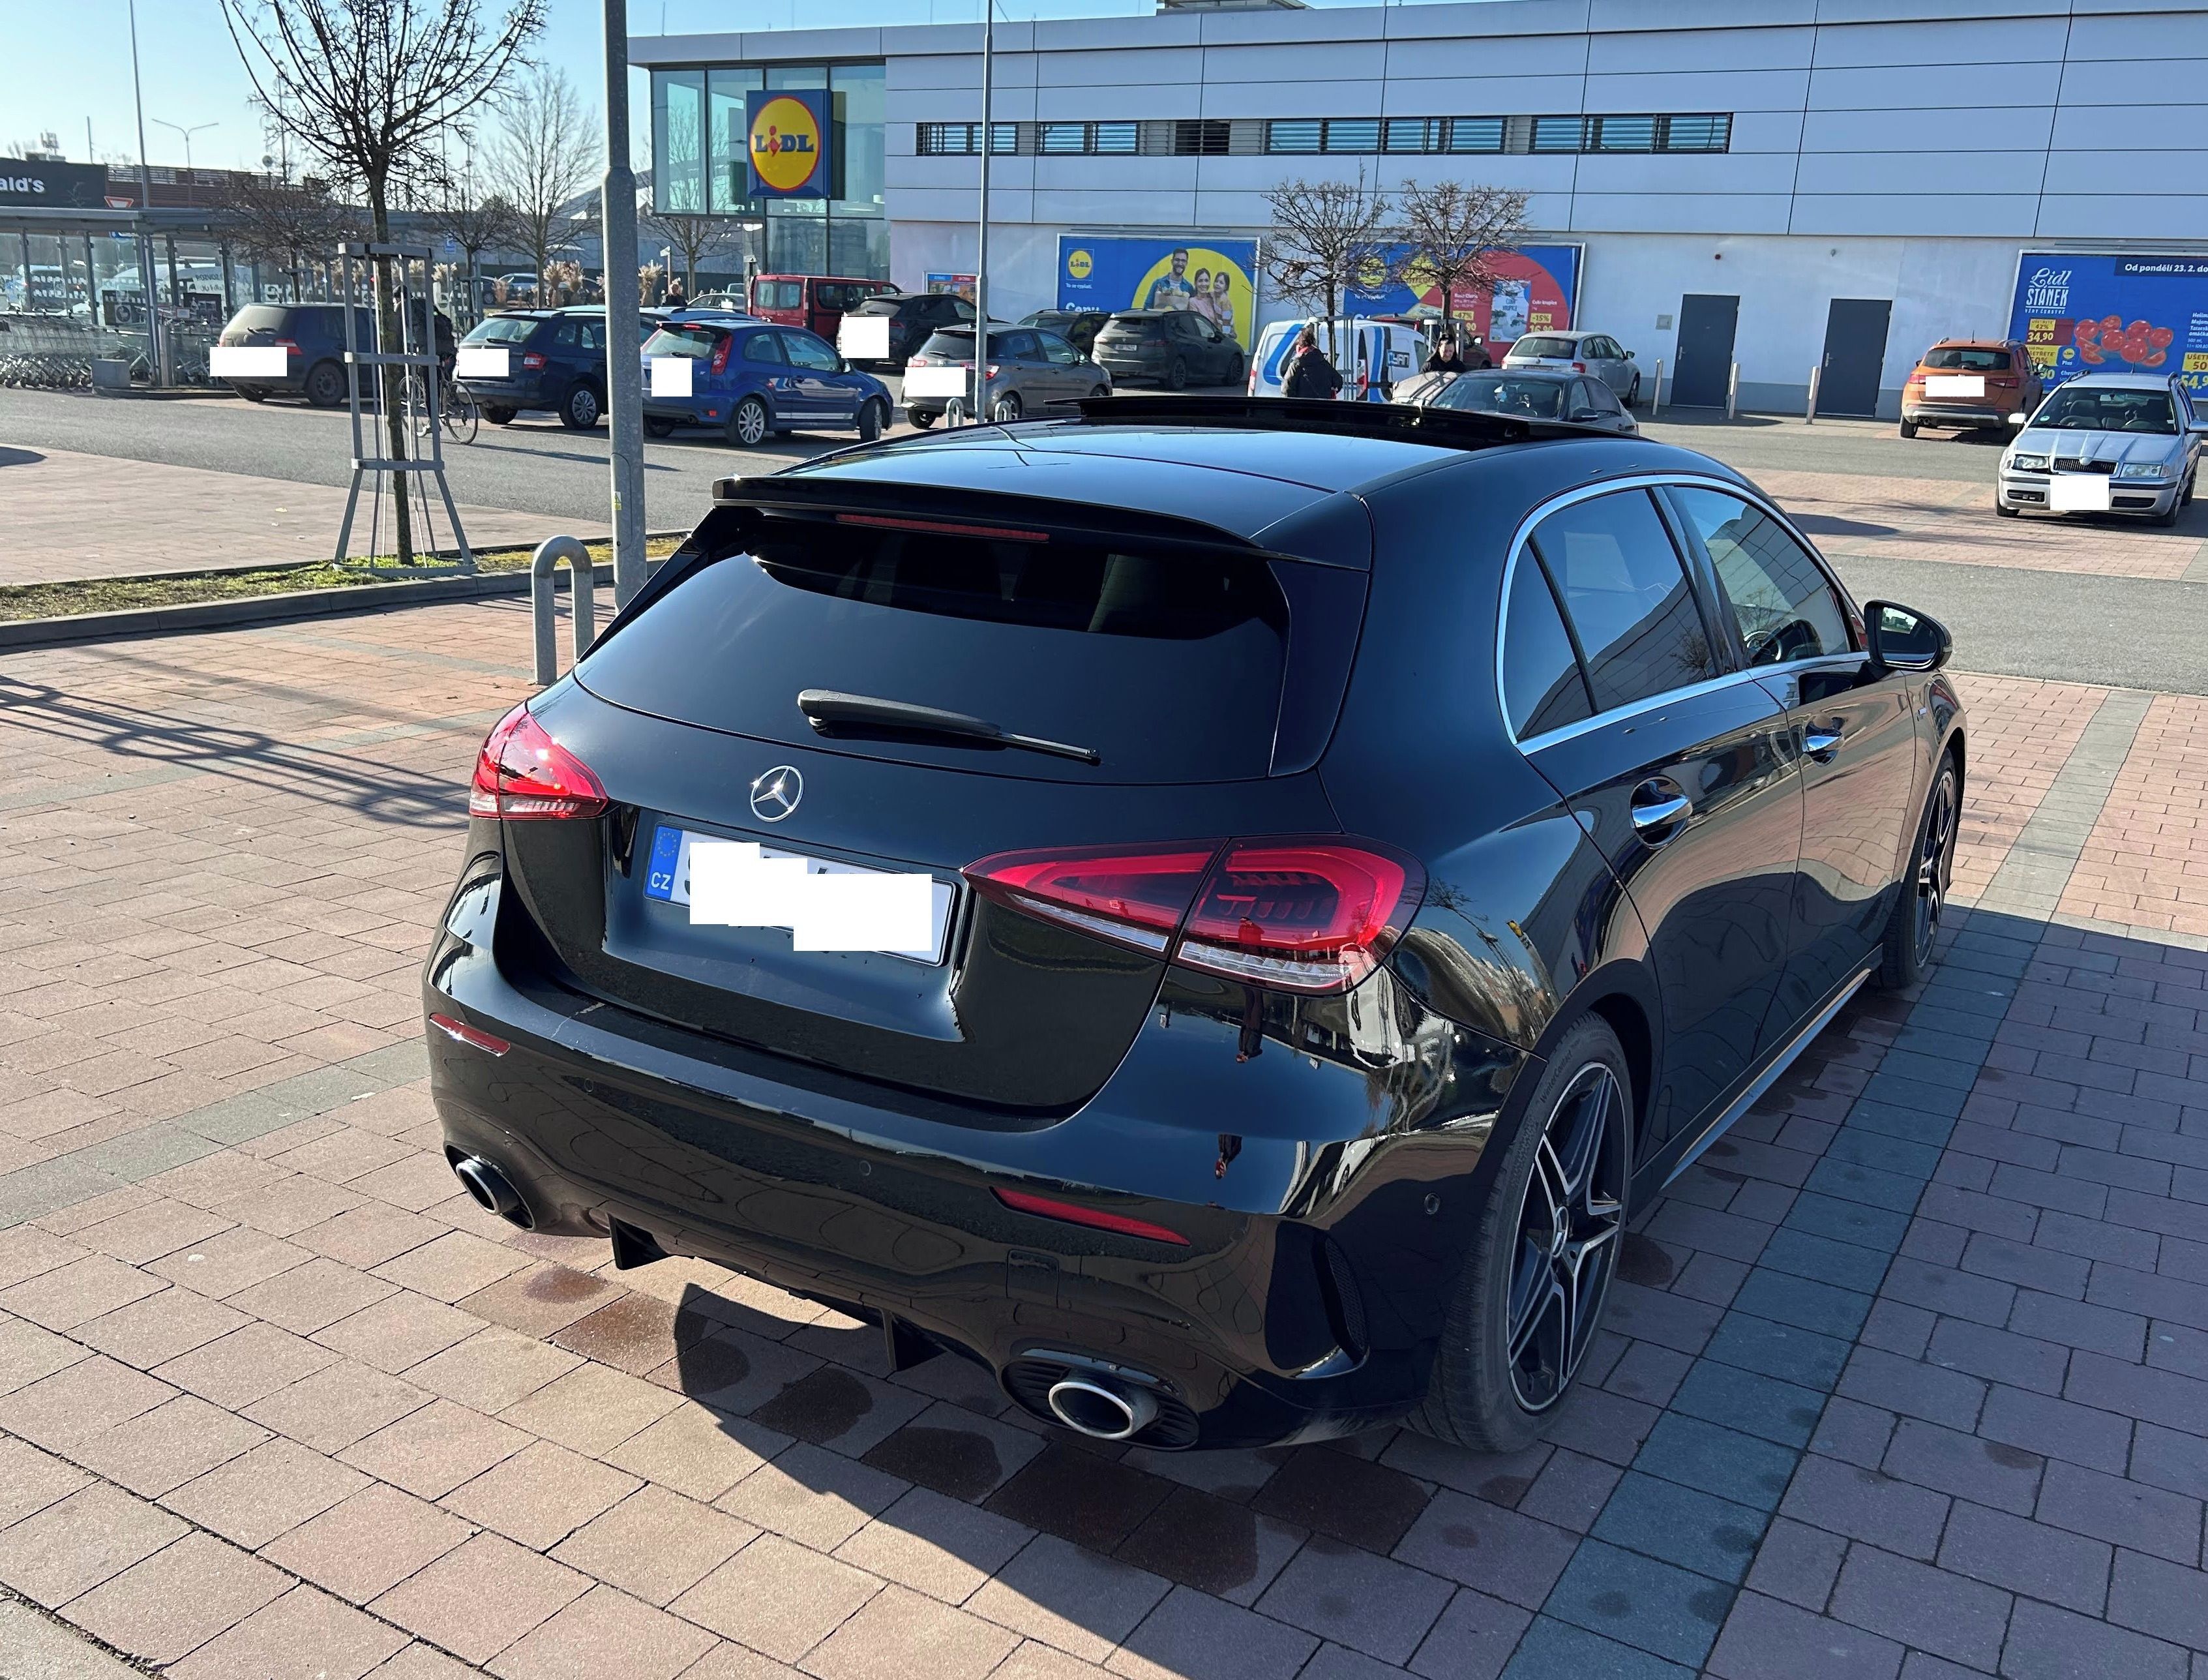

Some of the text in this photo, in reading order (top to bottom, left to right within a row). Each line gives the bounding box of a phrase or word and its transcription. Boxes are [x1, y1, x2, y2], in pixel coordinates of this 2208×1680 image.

[2030, 268, 2072, 287] Lidl
[2139, 263, 2173, 273] pondělí
[2026, 285, 2069, 307] STÁNEK
[2027, 331, 2054, 342] 34,90
[651, 872, 670, 891] CZ
